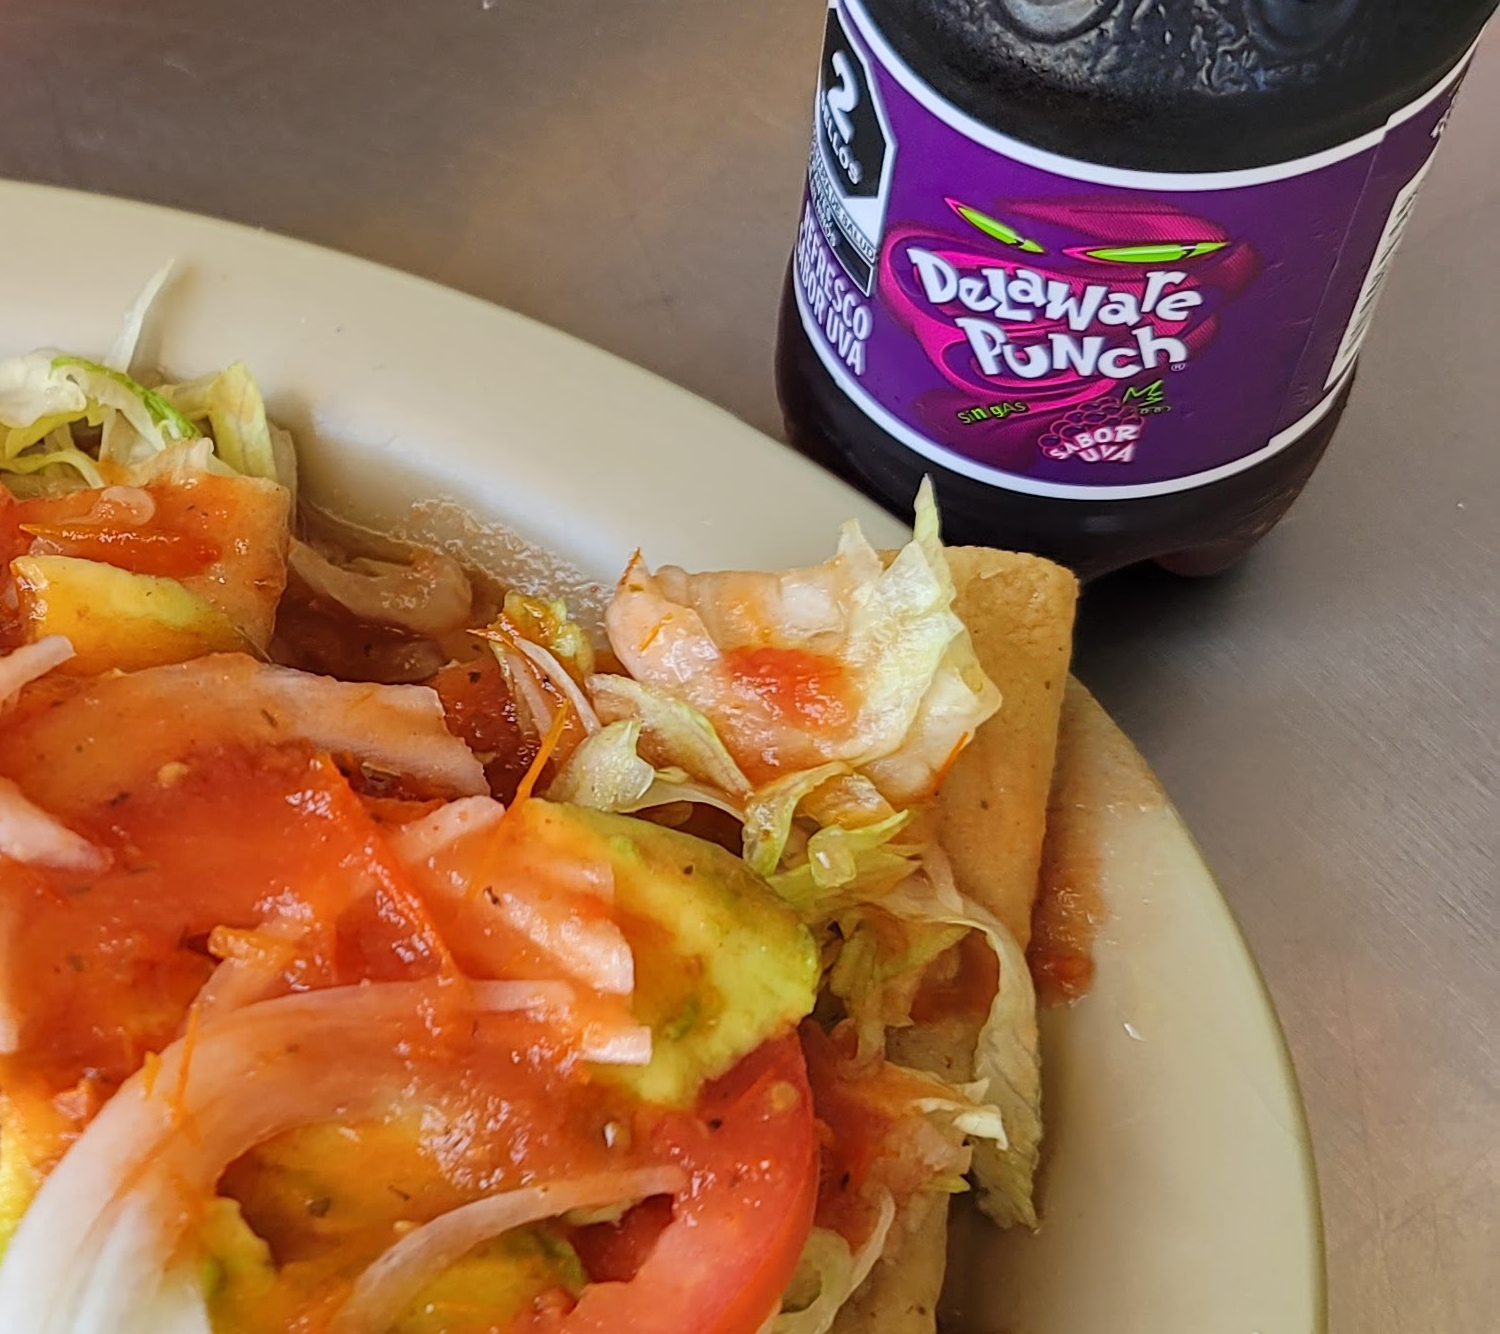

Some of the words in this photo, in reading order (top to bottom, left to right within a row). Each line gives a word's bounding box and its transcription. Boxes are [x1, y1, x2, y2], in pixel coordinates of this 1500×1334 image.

[826, 50, 859, 145] 2
[841, 213, 875, 261] SALUD
[804, 199, 873, 341] REFRESCO
[825, 305, 867, 376] UVA
[1049, 424, 1140, 461] SABOR
[1077, 442, 1137, 463] UVA
